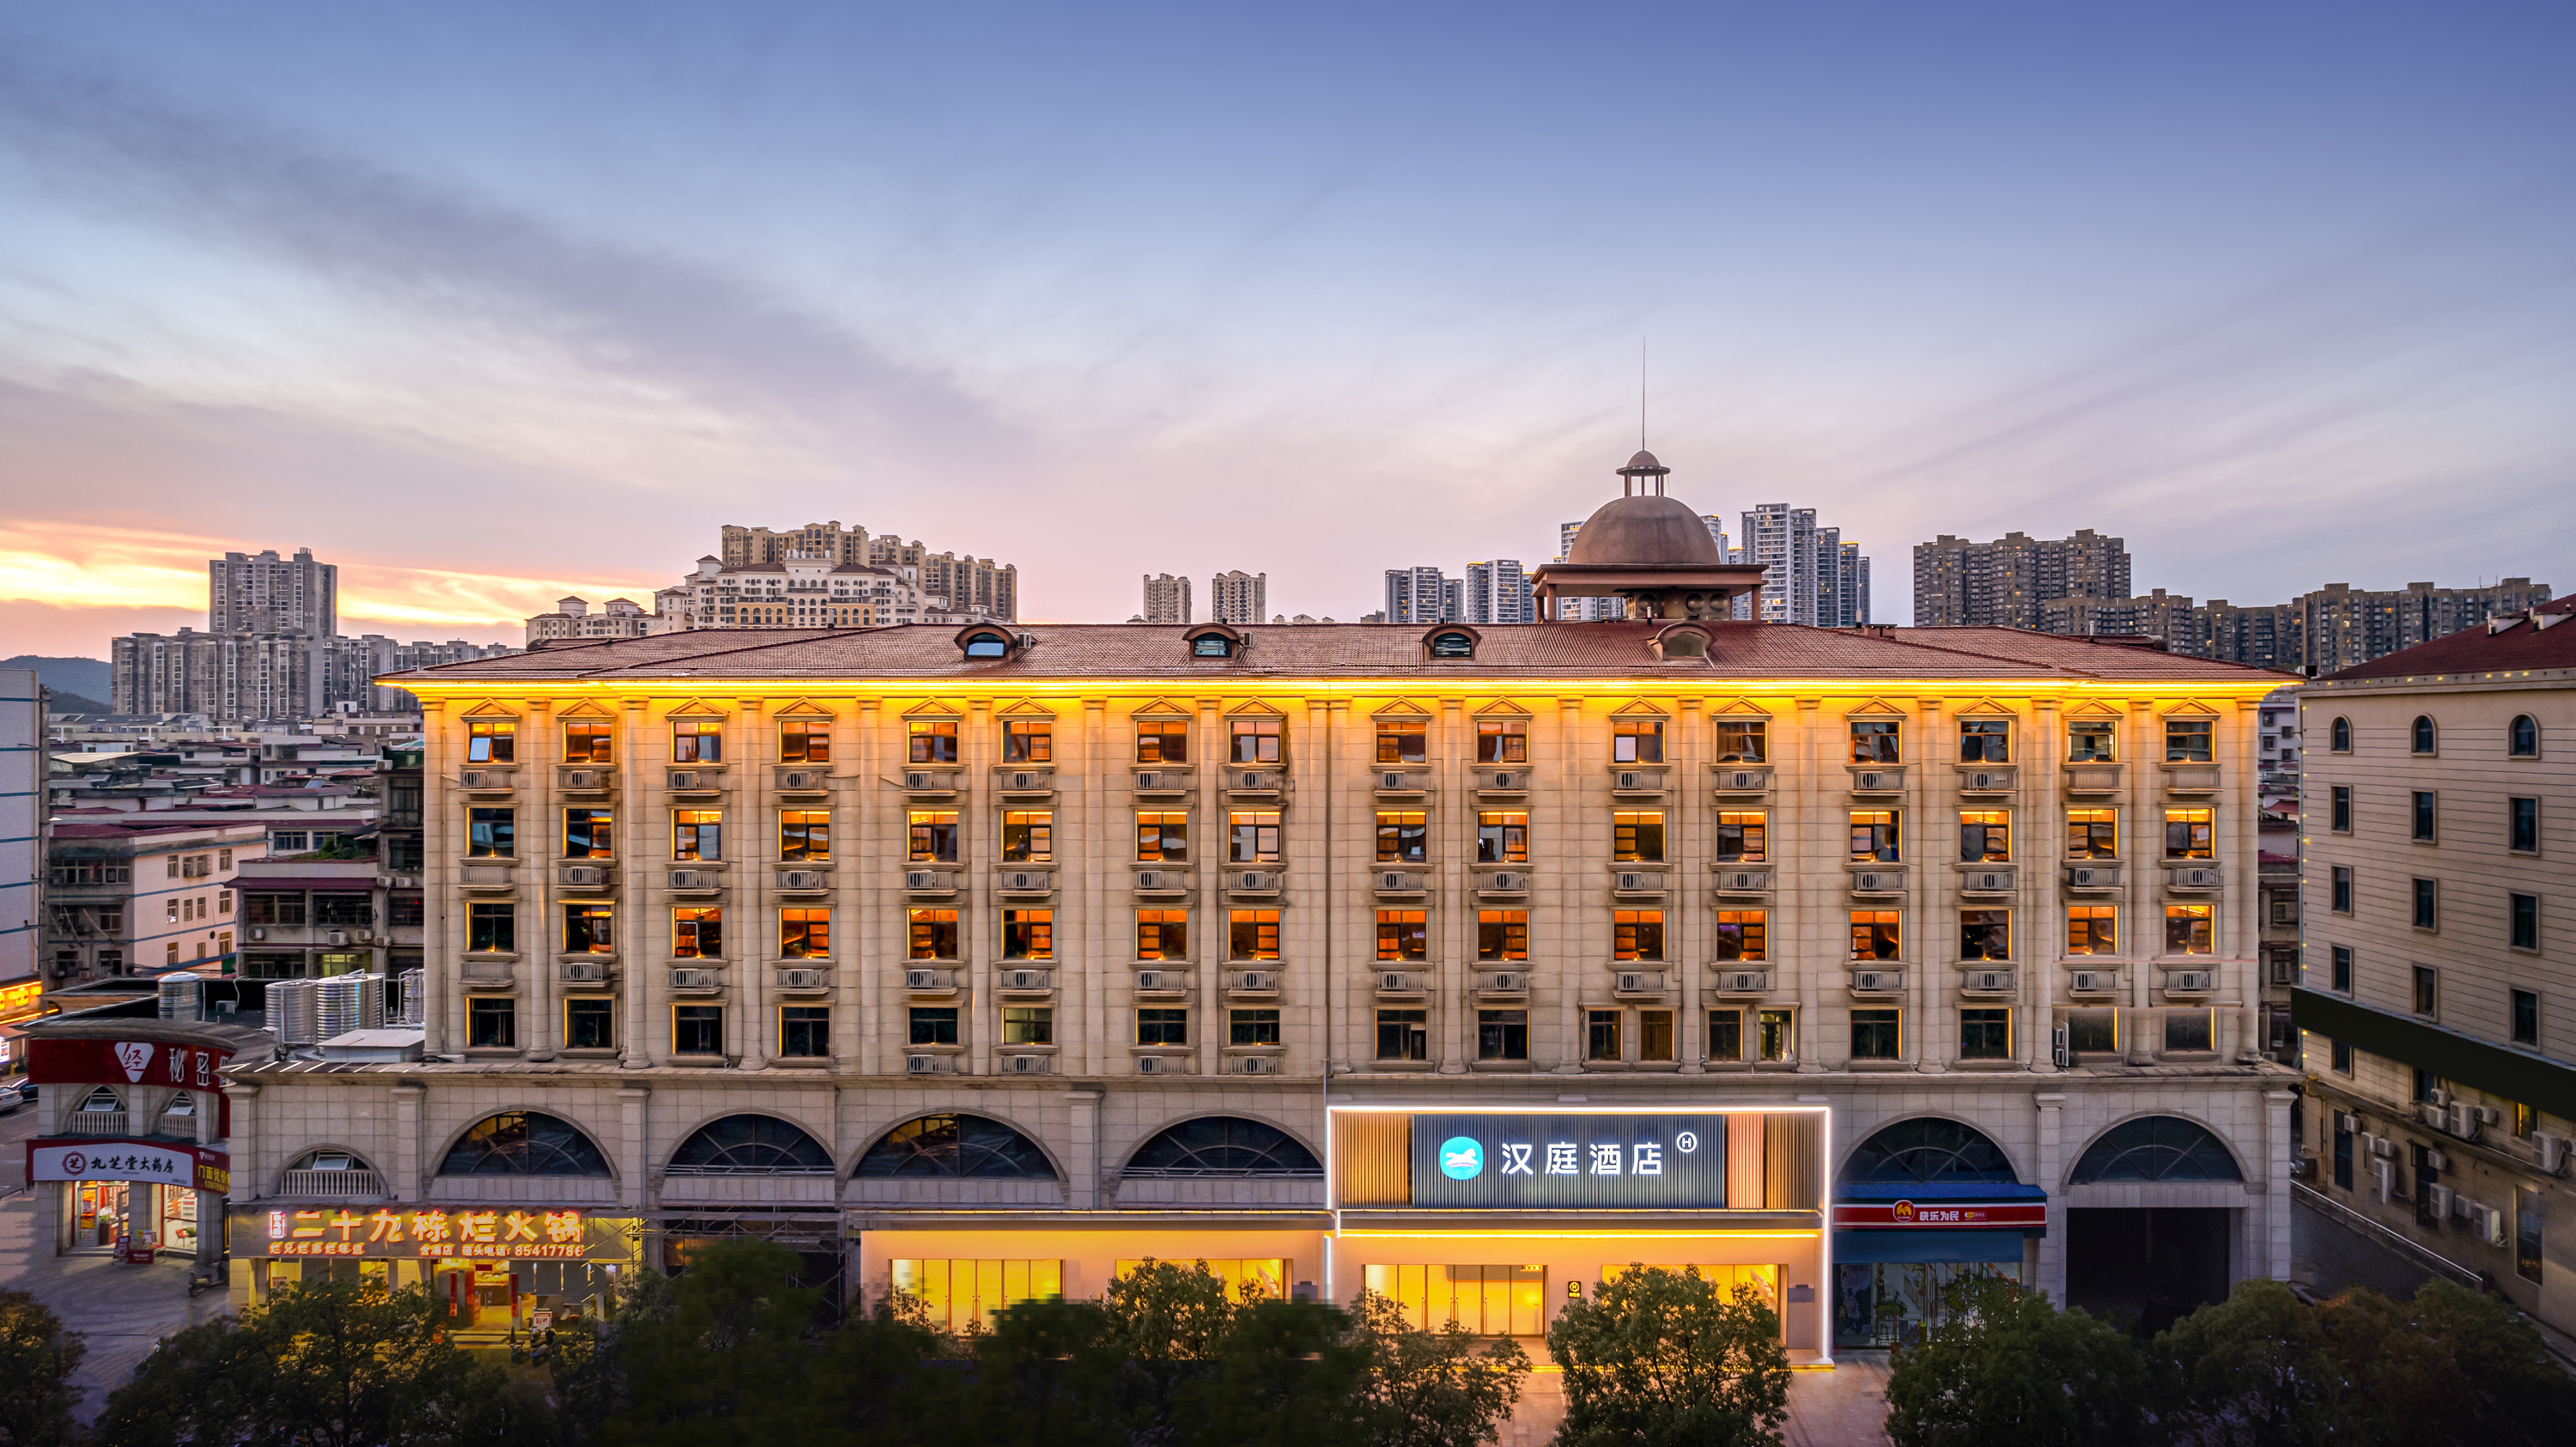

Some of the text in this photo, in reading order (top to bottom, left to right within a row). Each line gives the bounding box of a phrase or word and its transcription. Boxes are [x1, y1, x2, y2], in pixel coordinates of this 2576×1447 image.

[123, 1043, 145, 1072] 经
[91, 1155, 174, 1174] 九芝堂大药房
[1501, 1141, 1662, 1175] 汉庭酒店
[292, 1208, 583, 1243] 二十九栋烂火锅
[1919, 1211, 1959, 1221] 快乐为民
[269, 1242, 365, 1255] 烂兄烂弟烂味道
[514, 1244, 584, 1256] 85417786
